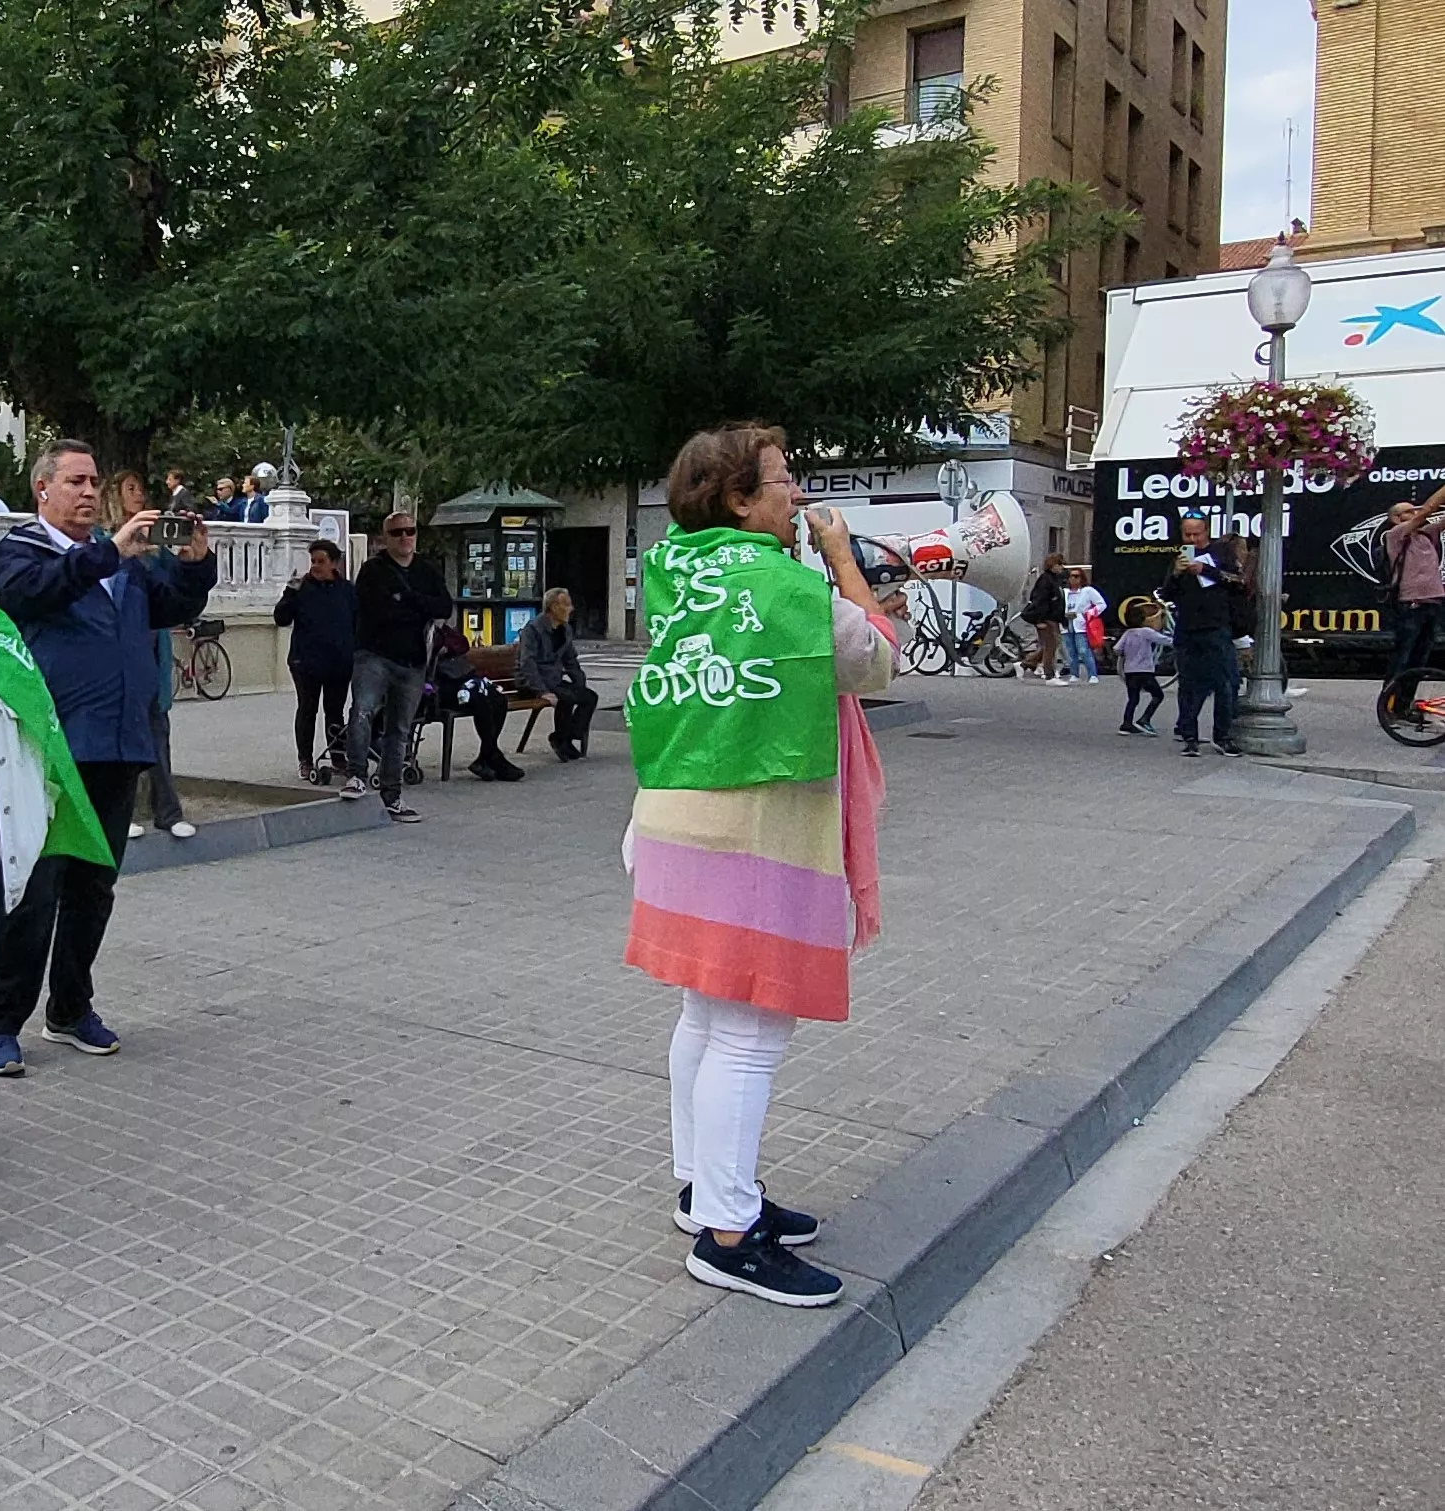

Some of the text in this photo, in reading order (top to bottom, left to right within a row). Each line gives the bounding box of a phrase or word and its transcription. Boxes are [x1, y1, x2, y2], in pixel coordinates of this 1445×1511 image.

[802, 471, 896, 493] DENT
[1114, 507, 1169, 541] da
[914, 558, 952, 573] CGT
